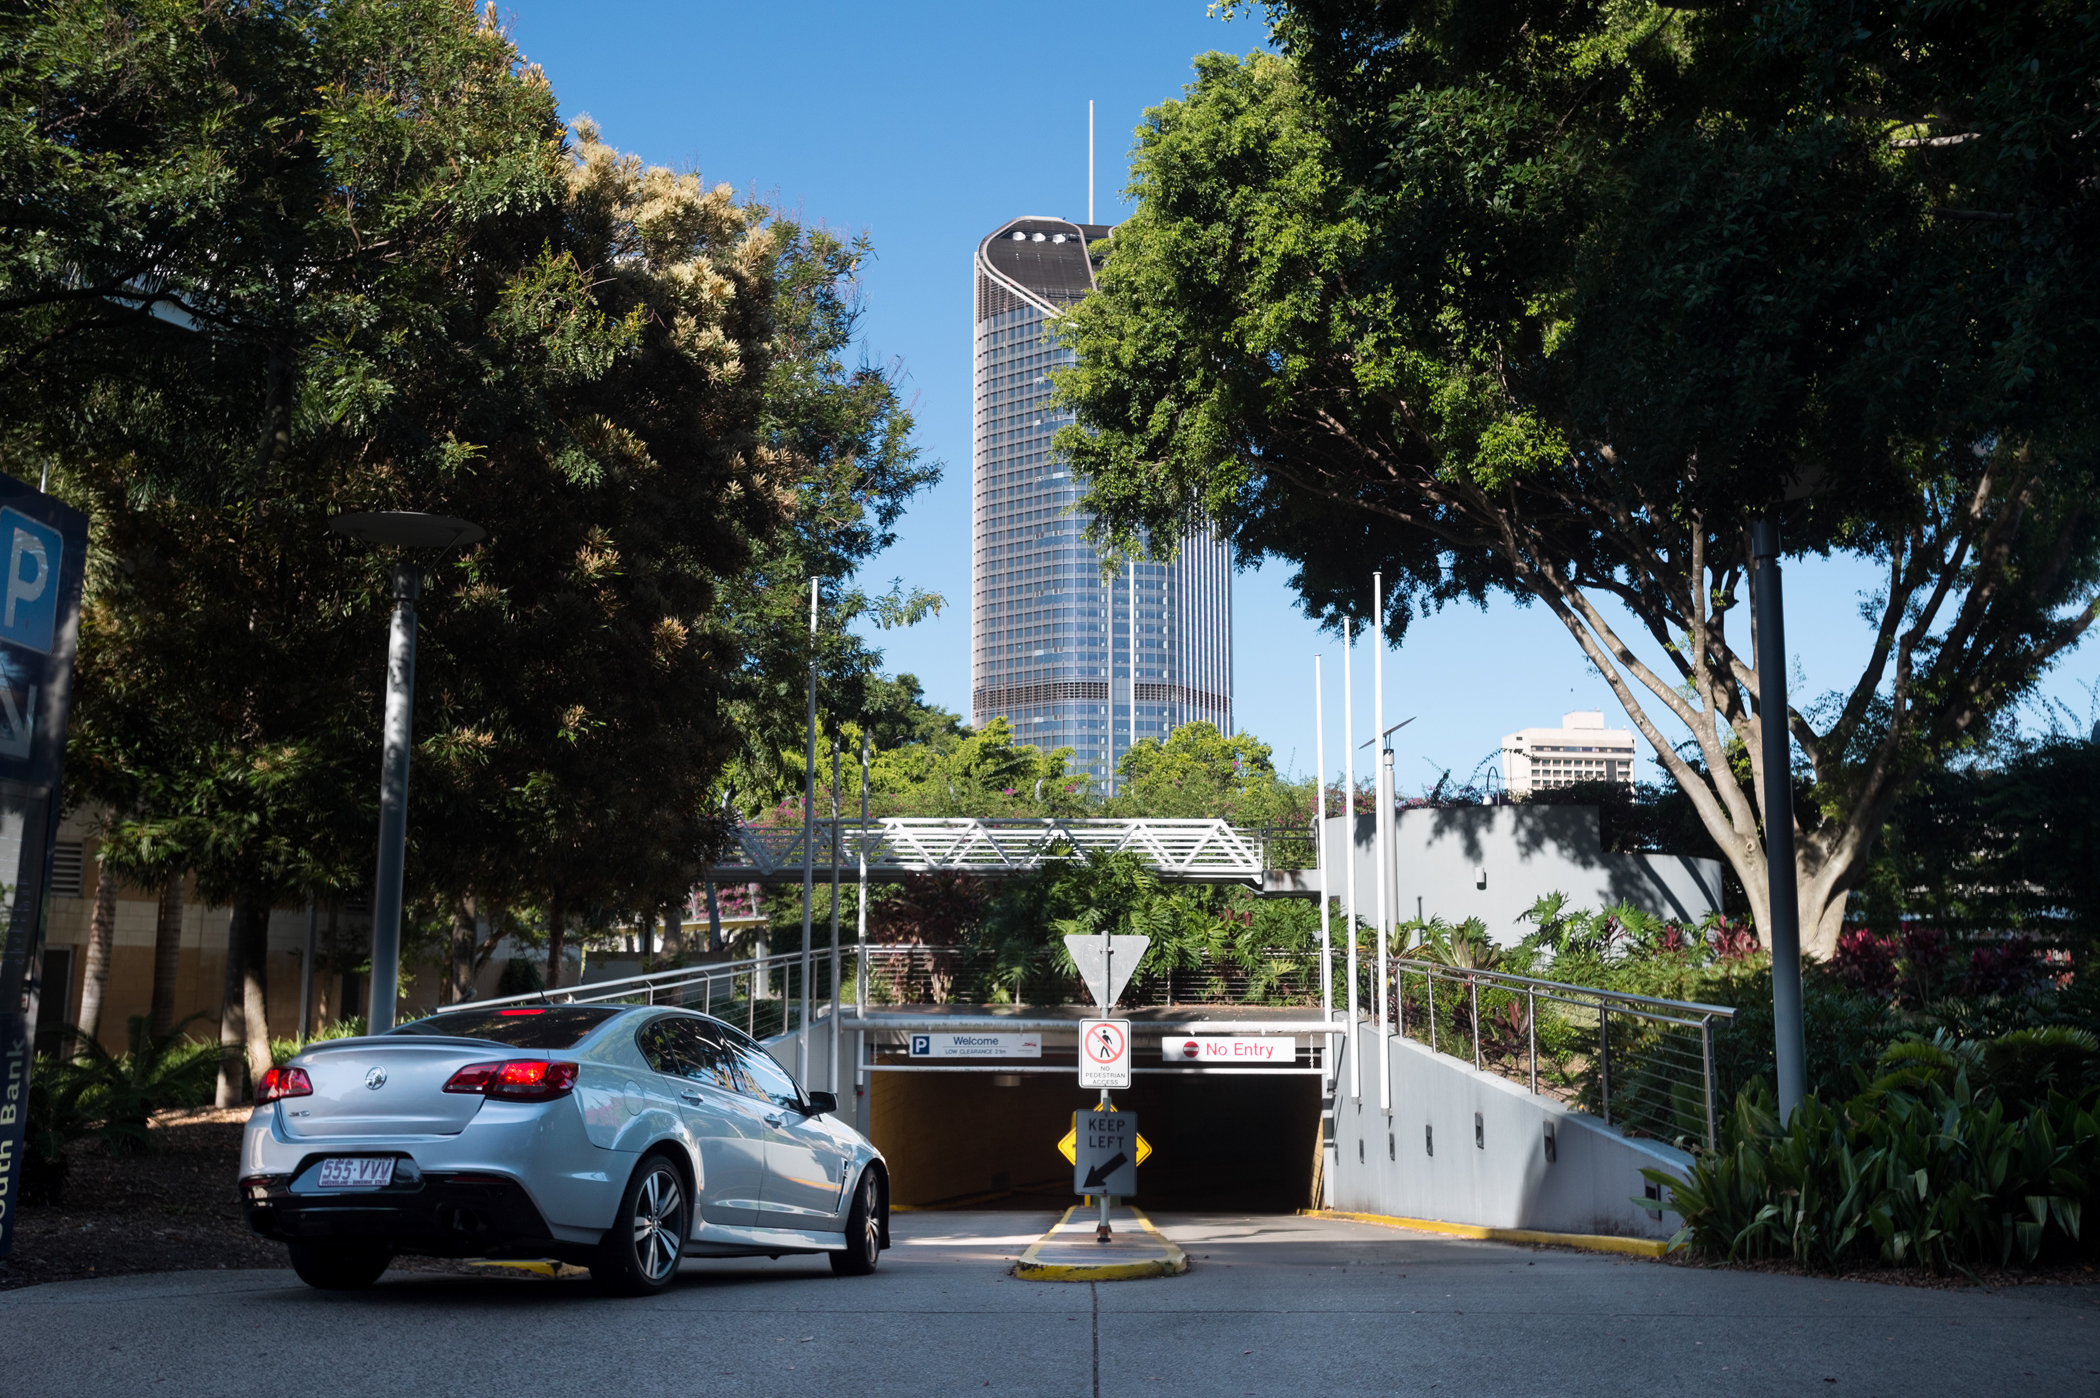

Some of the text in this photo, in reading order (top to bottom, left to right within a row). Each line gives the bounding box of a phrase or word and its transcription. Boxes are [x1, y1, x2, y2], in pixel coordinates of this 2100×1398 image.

[4, 527, 48, 628] P
[915, 1038, 928, 1053] P
[953, 1036, 999, 1046] Welcome
[1206, 1043, 1274, 1059] No Entry
[1089, 1118, 1126, 1132] KEEP
[0, 1038, 25, 1240] outh Bank
[1089, 1136, 1125, 1149] LEFT
